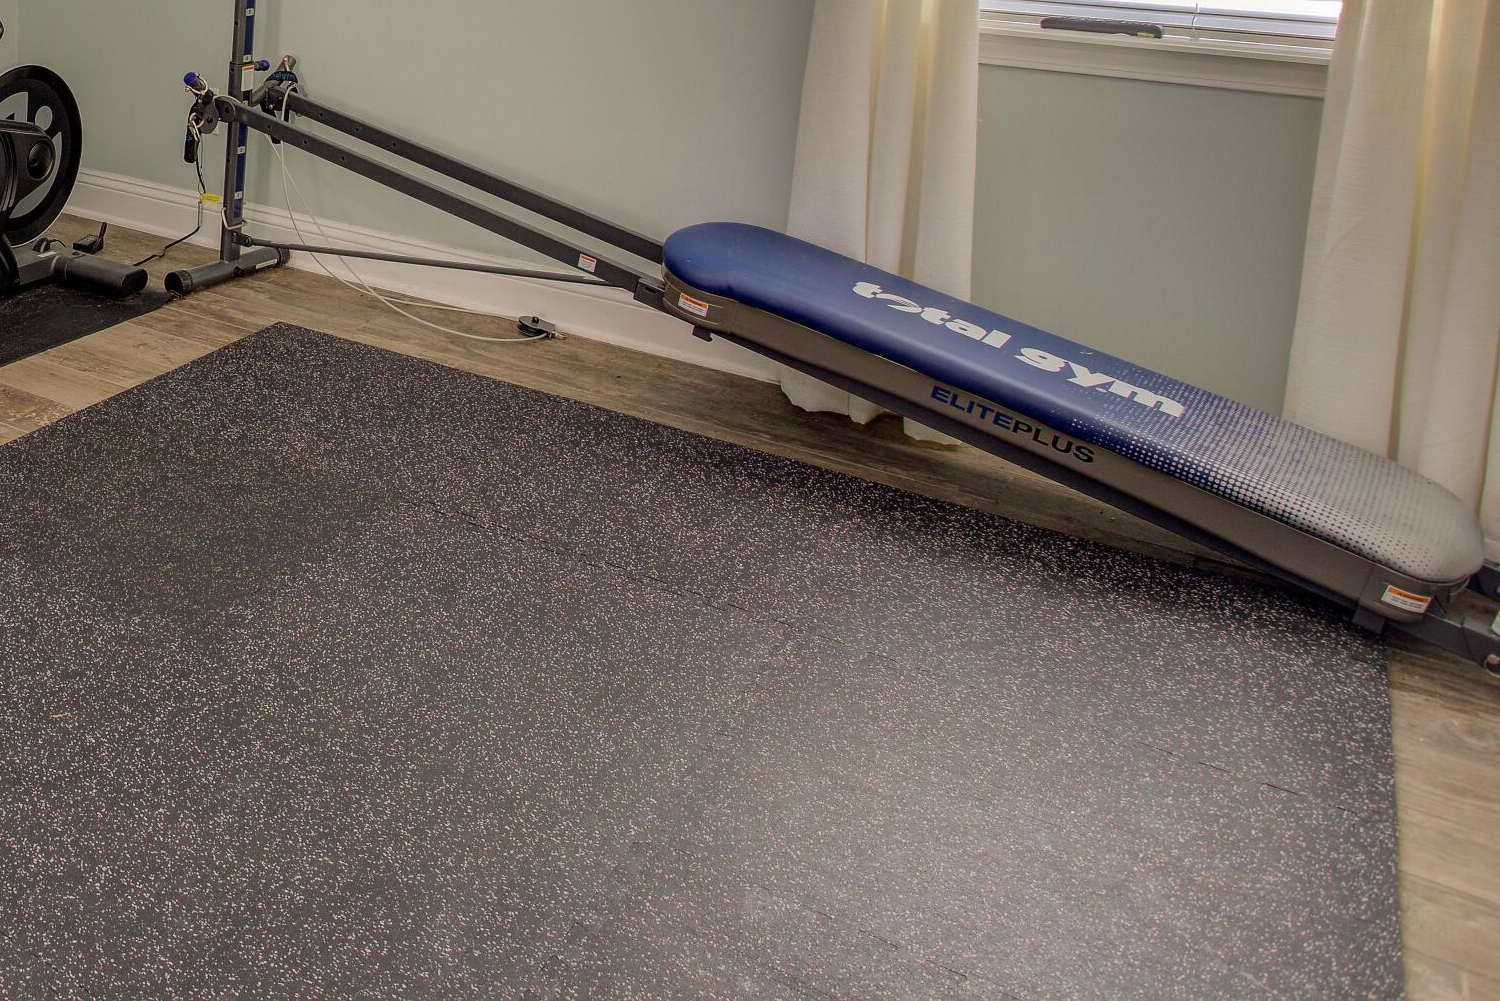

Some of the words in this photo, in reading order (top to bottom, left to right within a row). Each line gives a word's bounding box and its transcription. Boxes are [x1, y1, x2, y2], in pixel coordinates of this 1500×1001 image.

[852, 281, 1012, 349] total
[1014, 347, 1185, 418] gym
[930, 385, 1095, 464] ELITEPLUS
